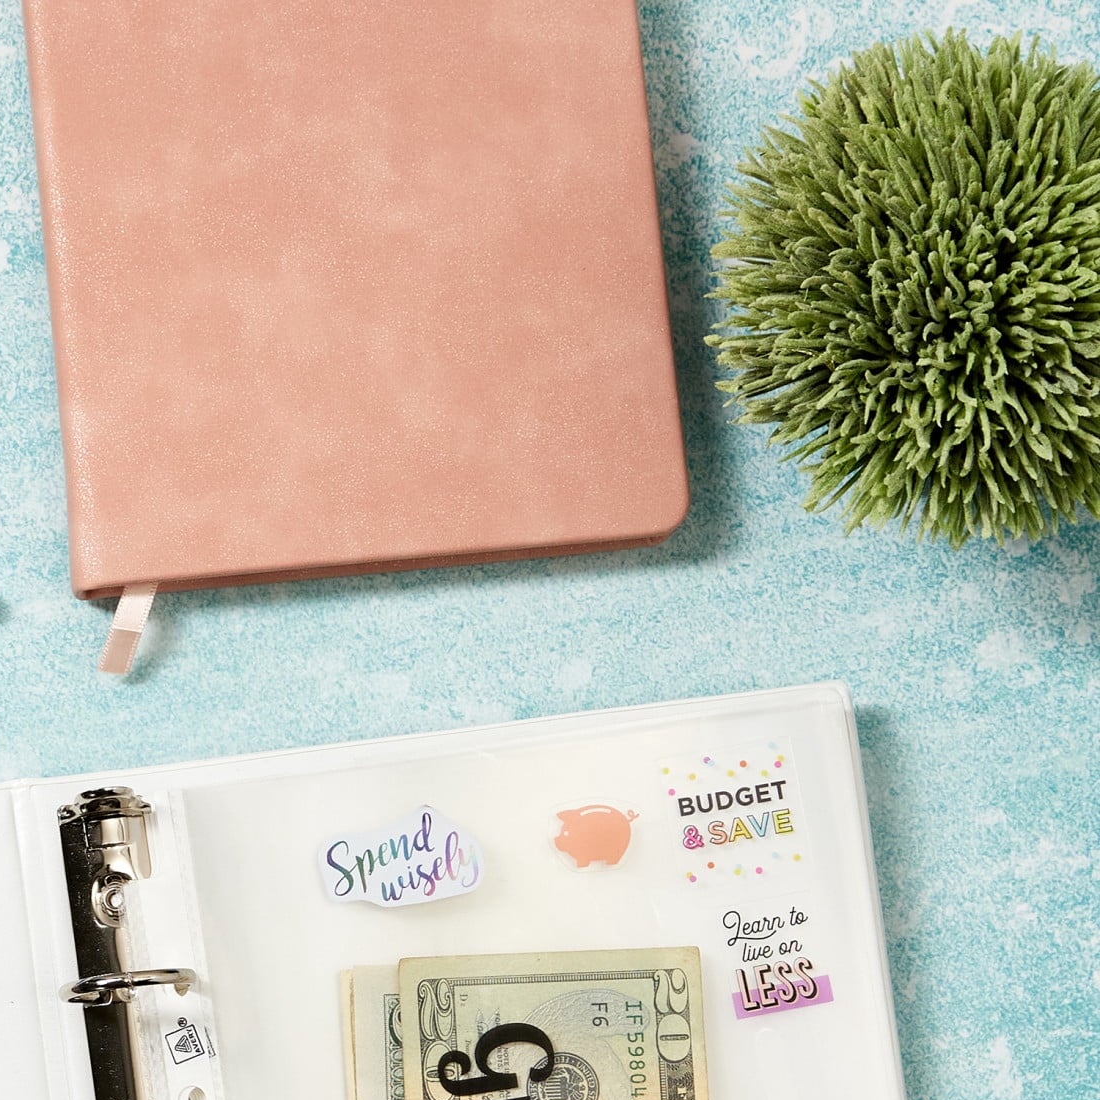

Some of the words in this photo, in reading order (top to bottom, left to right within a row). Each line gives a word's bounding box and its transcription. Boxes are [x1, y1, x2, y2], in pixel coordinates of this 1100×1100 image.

[677, 780, 788, 817] BUDGET
[682, 825, 705, 850] &
[710, 808, 795, 846] SAVE
[326, 812, 435, 897] Spend
[381, 831, 480, 902] wisely
[723, 910, 784, 946] Learn
[785, 906, 808, 929] to
[742, 939, 774, 963] live
[778, 938, 802, 955] on
[735, 957, 819, 1012] LESS
[590, 1001, 609, 1028] F6
[653, 968, 691, 1063] 20
[185, 1028, 202, 1054] AVERY
